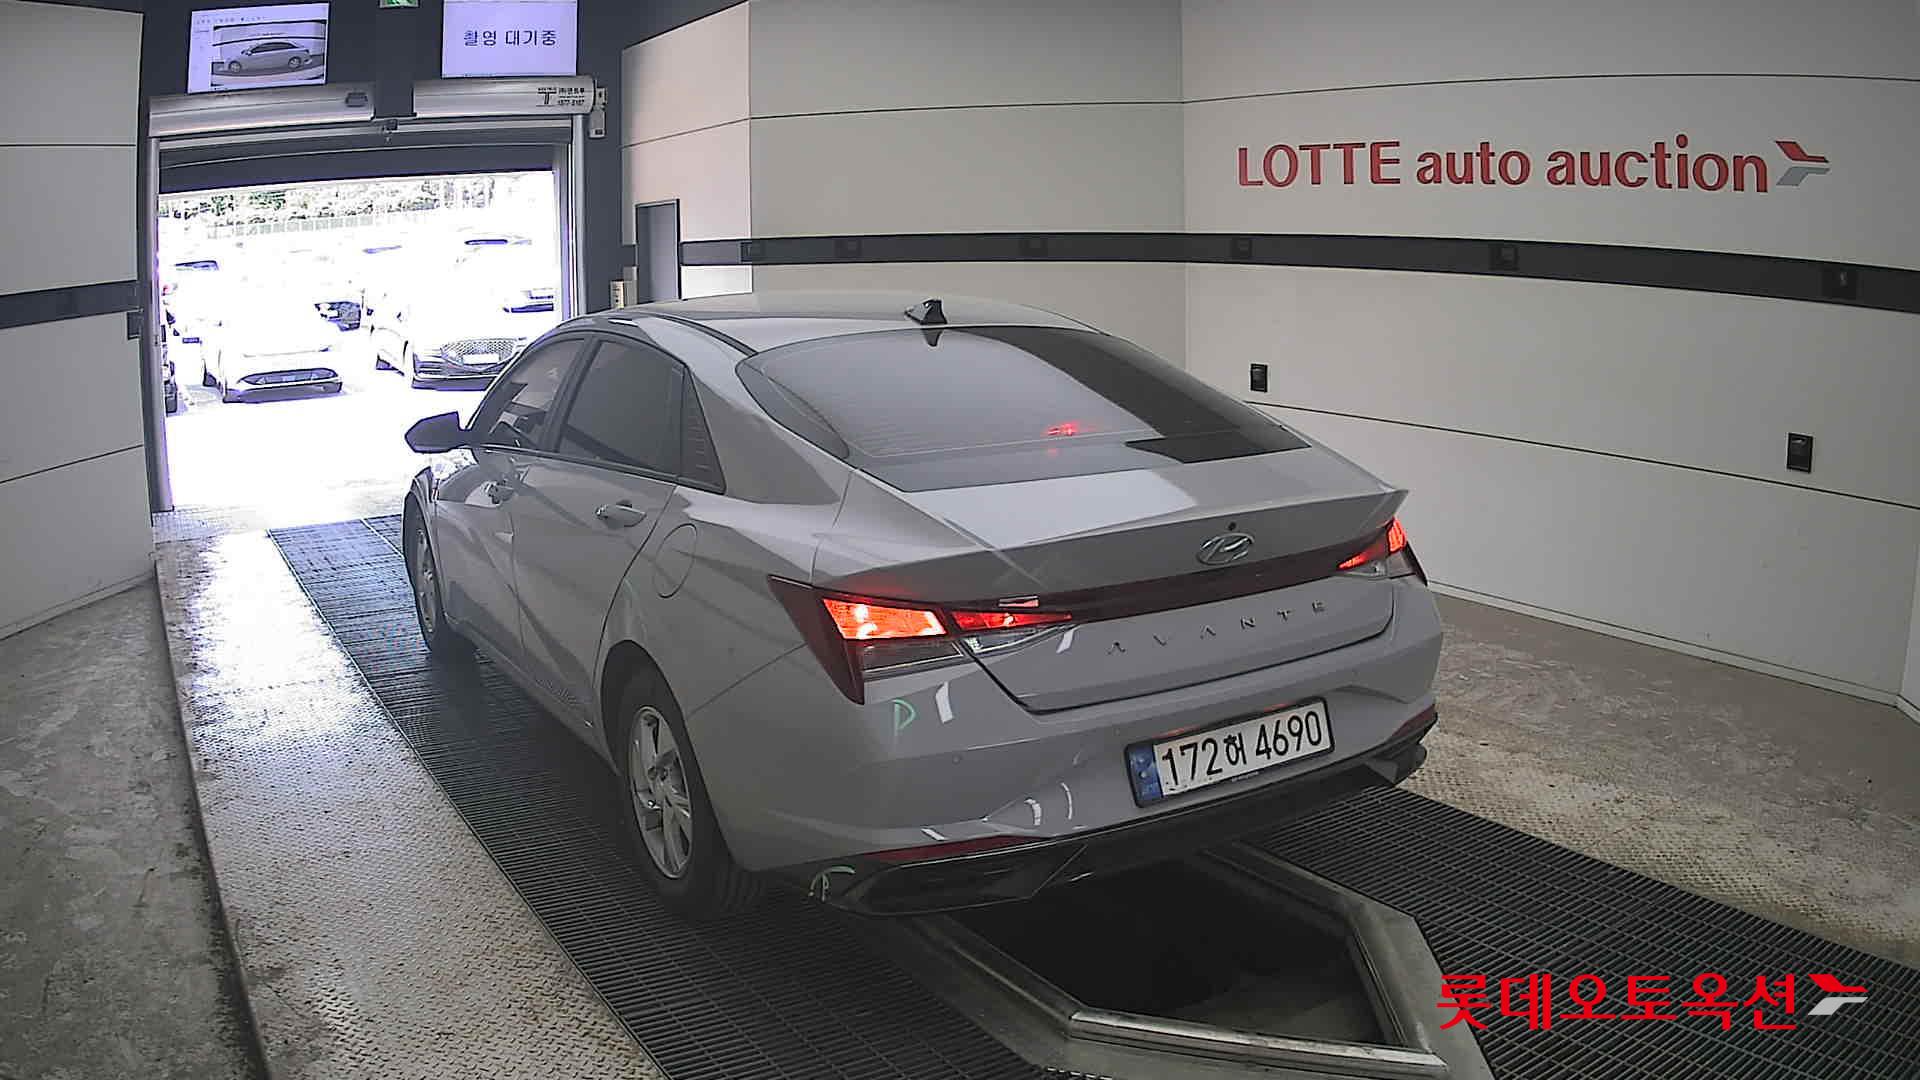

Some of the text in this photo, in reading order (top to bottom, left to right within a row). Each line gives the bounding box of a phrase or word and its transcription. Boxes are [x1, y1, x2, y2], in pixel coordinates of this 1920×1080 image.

[463, 30, 557, 46] 촬영 대기중
[1237, 134, 1769, 193] LOTTE auto auction
[1107, 600, 1326, 656] AVANTE
[1162, 710, 1323, 786] 172허 4690
